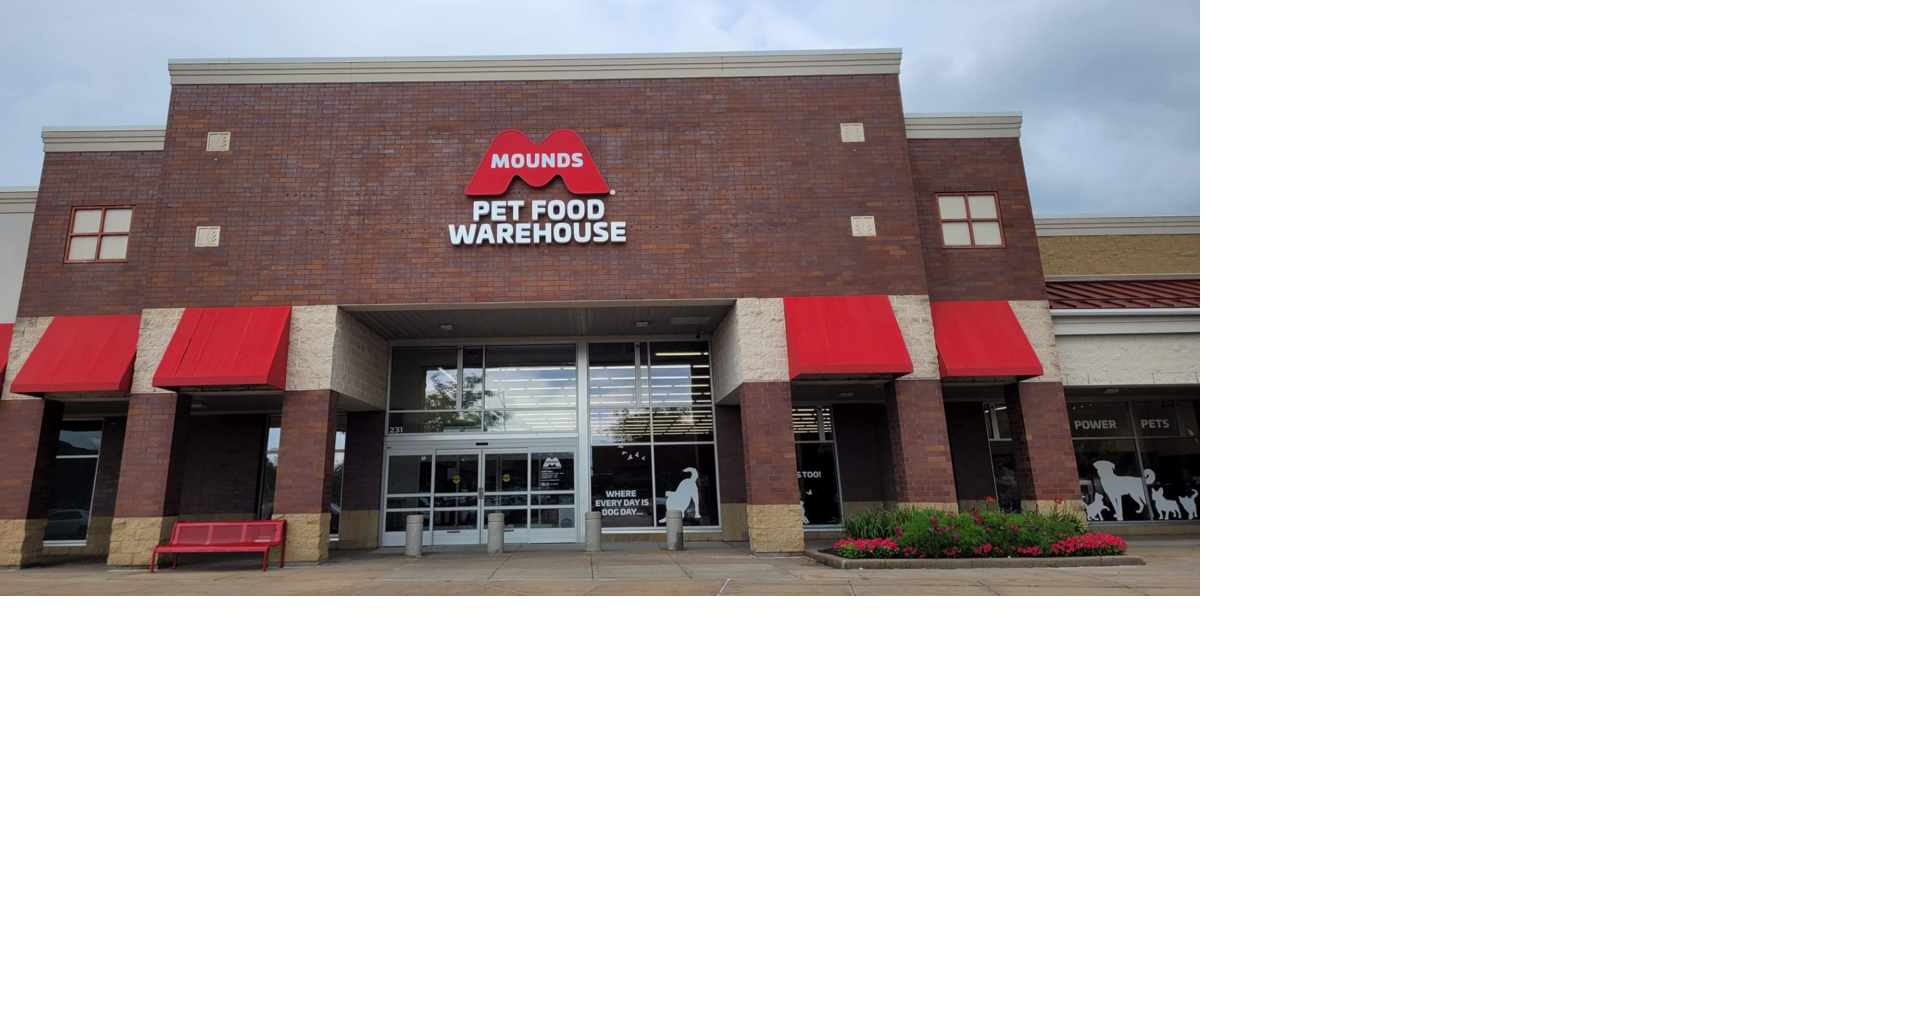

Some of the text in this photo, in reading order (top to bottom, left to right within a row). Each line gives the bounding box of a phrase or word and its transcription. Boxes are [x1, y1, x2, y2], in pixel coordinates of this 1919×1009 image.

[491, 153, 583, 168] MOUNDS
[473, 199, 604, 222] PET FOOD
[448, 221, 627, 245] WAREHOUSE
[1074, 419, 1117, 429] POWER
[1140, 419, 1170, 429] PETS
[641, 498, 649, 506] IS
